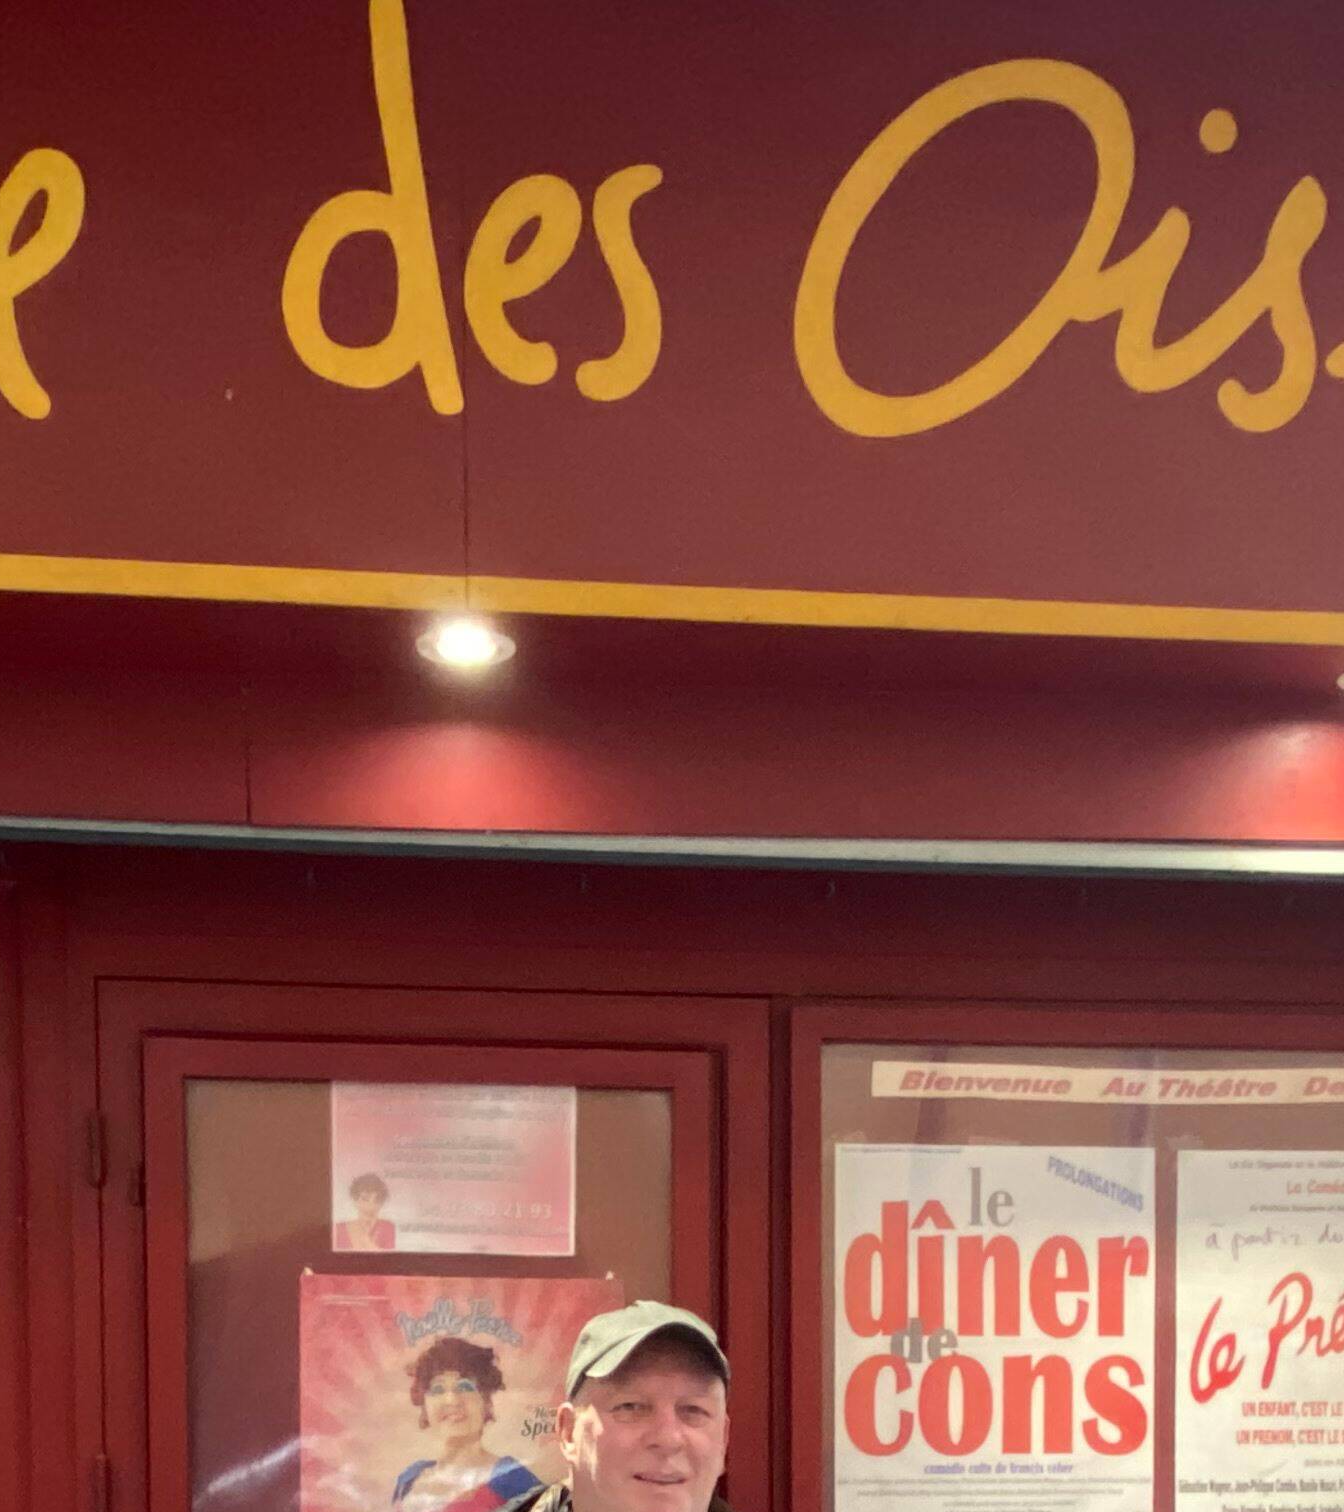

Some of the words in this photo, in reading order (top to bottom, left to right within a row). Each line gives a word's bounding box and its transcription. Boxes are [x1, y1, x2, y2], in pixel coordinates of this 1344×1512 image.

[281, 0, 664, 416] des
[897, 1070, 1072, 1095] Bienvenue
[1100, 1074, 1147, 1097] Au
[1156, 1075, 1278, 1098] Théâtre
[968, 1166, 1015, 1228] le
[1046, 1155, 1145, 1213] PROLONGATIONS
[844, 1200, 1150, 1339] dîner
[890, 1317, 958, 1363] de
[844, 1354, 1149, 1457] cons
[1330, 1401, 1344, 1418] LE
[1328, 1429, 1340, 1445] LE
